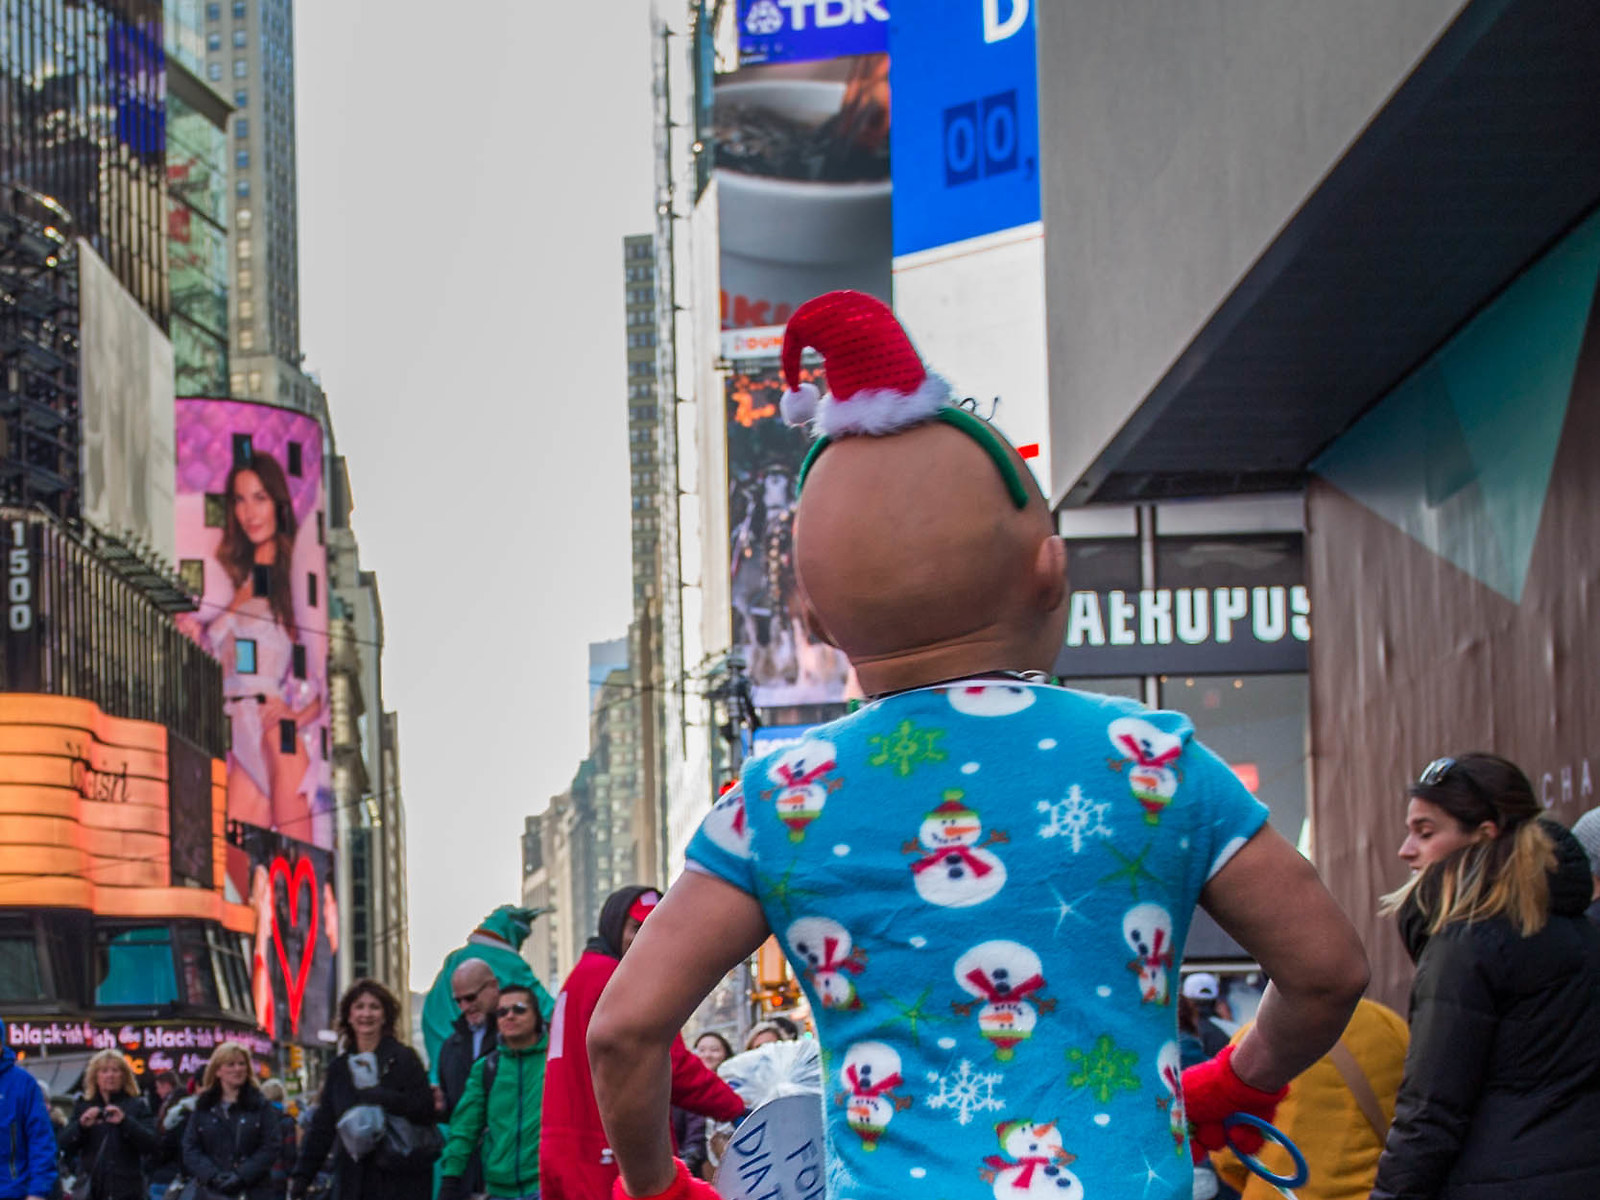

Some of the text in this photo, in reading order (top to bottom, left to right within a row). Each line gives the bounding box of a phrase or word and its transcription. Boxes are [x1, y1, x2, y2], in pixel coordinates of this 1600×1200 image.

[777, 0, 891, 31] TDK
[982, 0, 1030, 43] D
[9, 521, 31, 632] 1500
